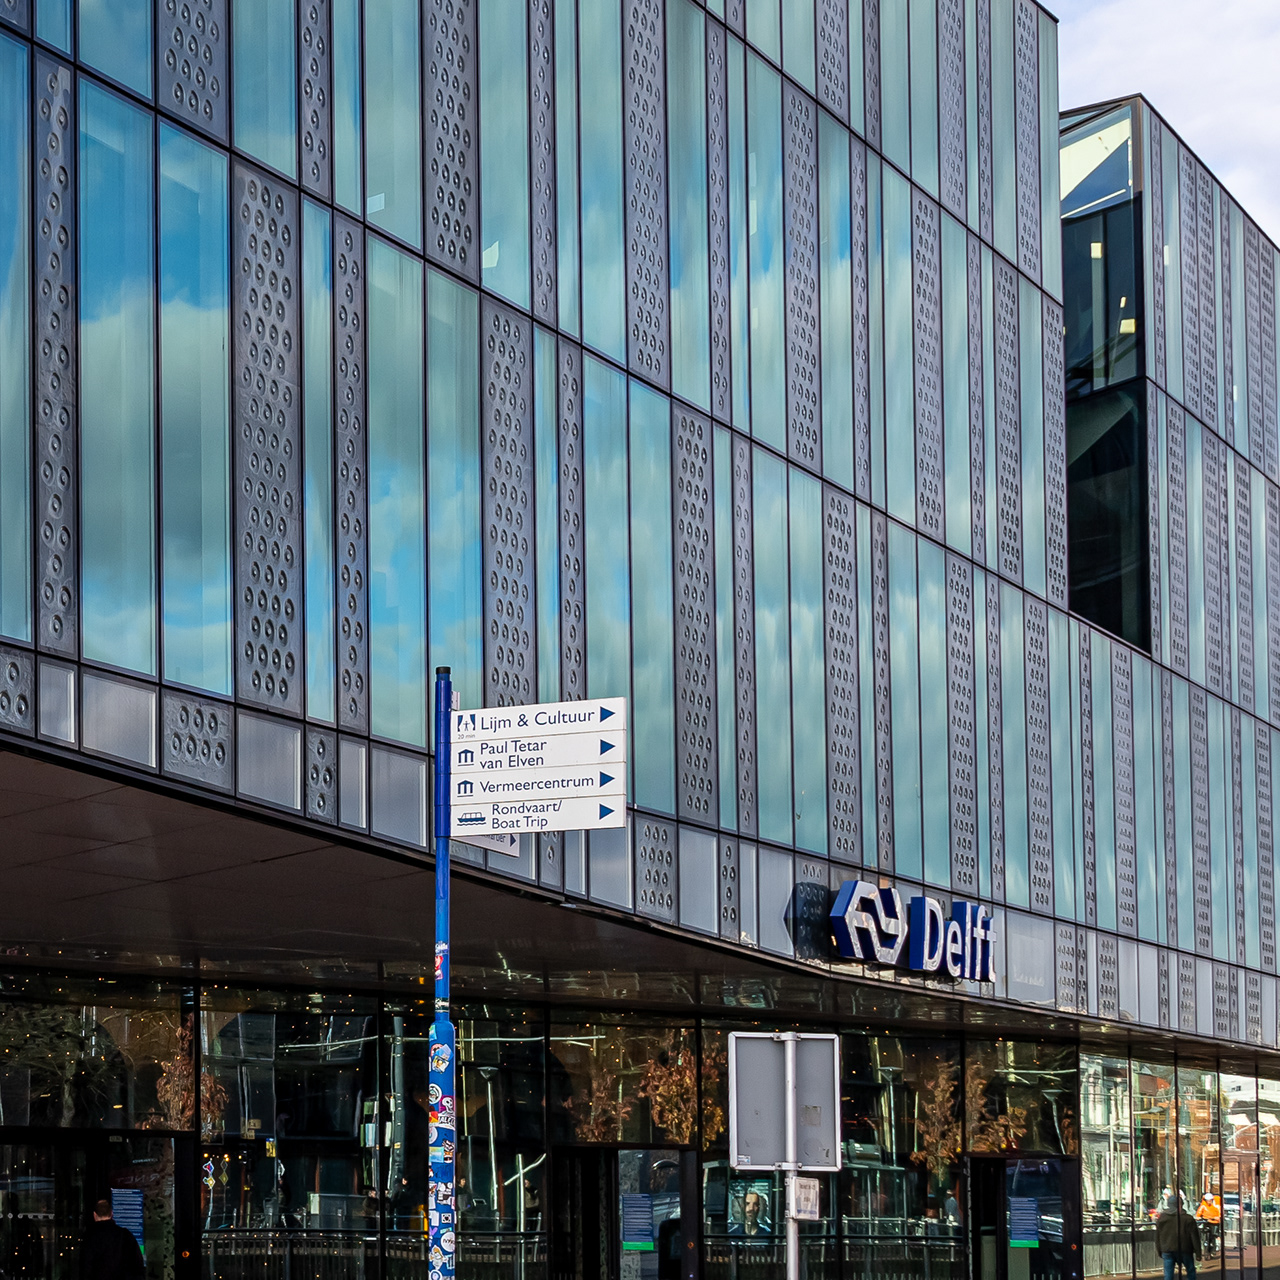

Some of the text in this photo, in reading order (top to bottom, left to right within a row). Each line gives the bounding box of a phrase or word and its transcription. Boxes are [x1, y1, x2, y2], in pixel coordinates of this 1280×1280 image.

[481, 710, 595, 733] Lijm & Cultuur
[480, 740, 547, 755] Paul Tetar
[480, 755, 544, 770] van Elven
[480, 777, 594, 793] Vermeercentrum
[492, 799, 563, 815] Rondvaart/
[492, 816, 548, 830] Boat Trip
[922, 896, 997, 983] Delft
